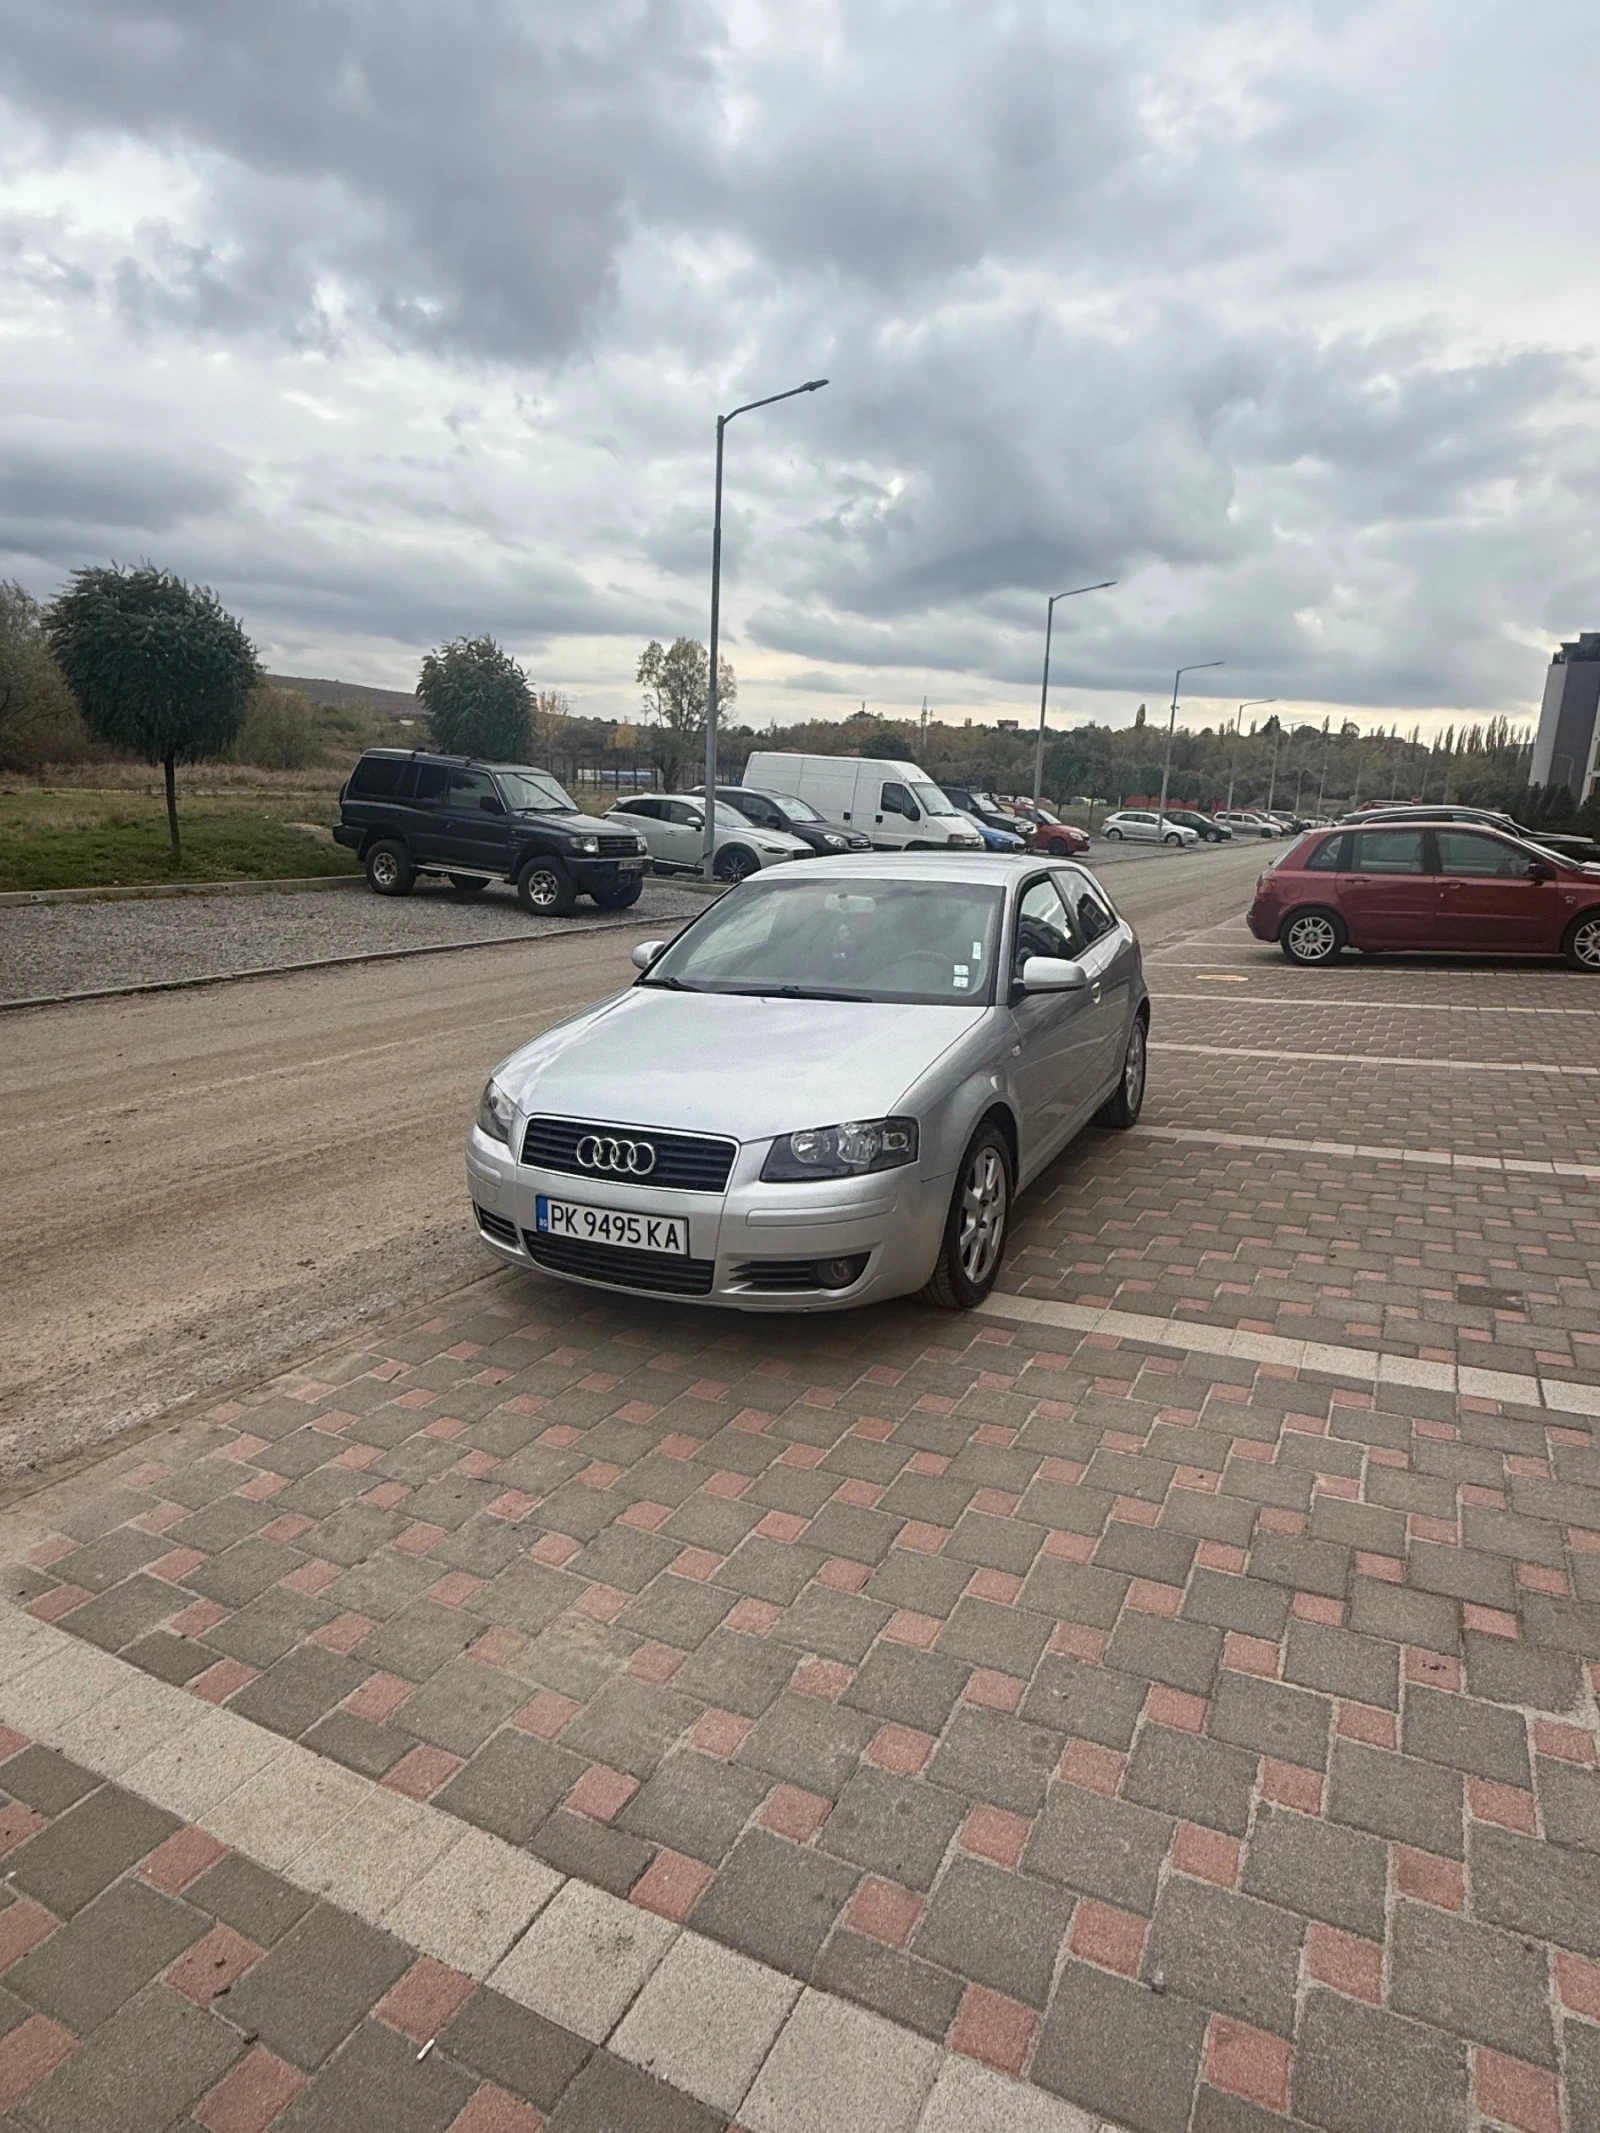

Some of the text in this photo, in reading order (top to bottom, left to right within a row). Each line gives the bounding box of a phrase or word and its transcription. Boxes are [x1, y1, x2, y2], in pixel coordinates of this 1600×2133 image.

[551, 1204, 680, 1250] PK 9495 KA
